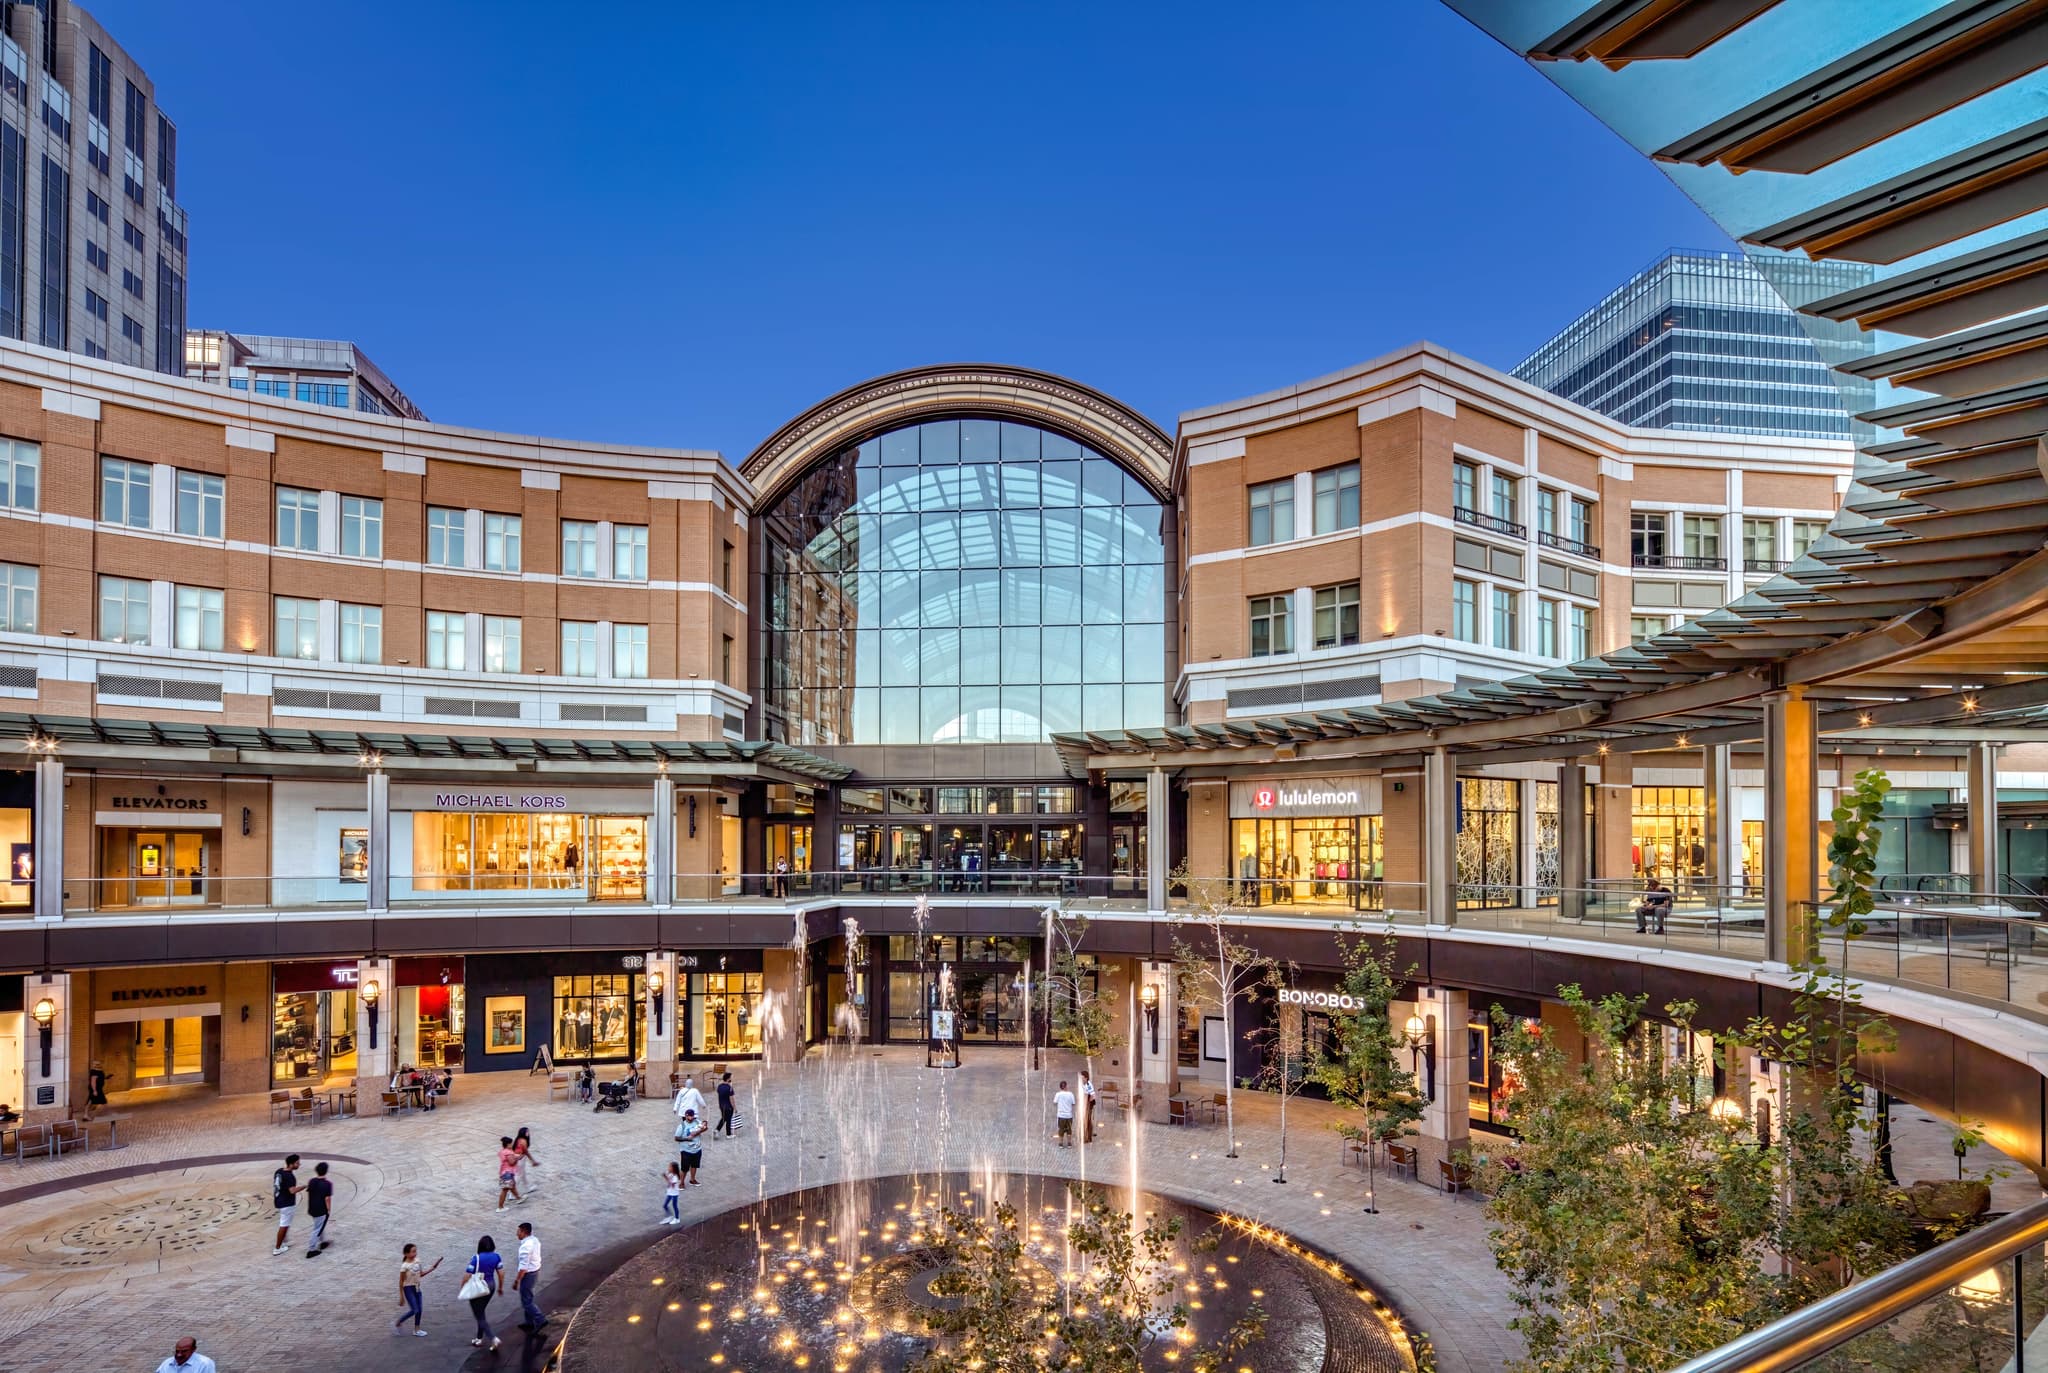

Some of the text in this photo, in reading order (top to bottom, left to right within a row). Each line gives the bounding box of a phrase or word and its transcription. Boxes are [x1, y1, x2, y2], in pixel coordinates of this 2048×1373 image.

[112, 797, 208, 809] ELEVATORS
[436, 793, 566, 808] MICHAEL KORS
[1279, 789, 1357, 806] lululemon
[111, 985, 208, 1002] ELEVATORS
[1279, 989, 1365, 1009] BONOBOS
